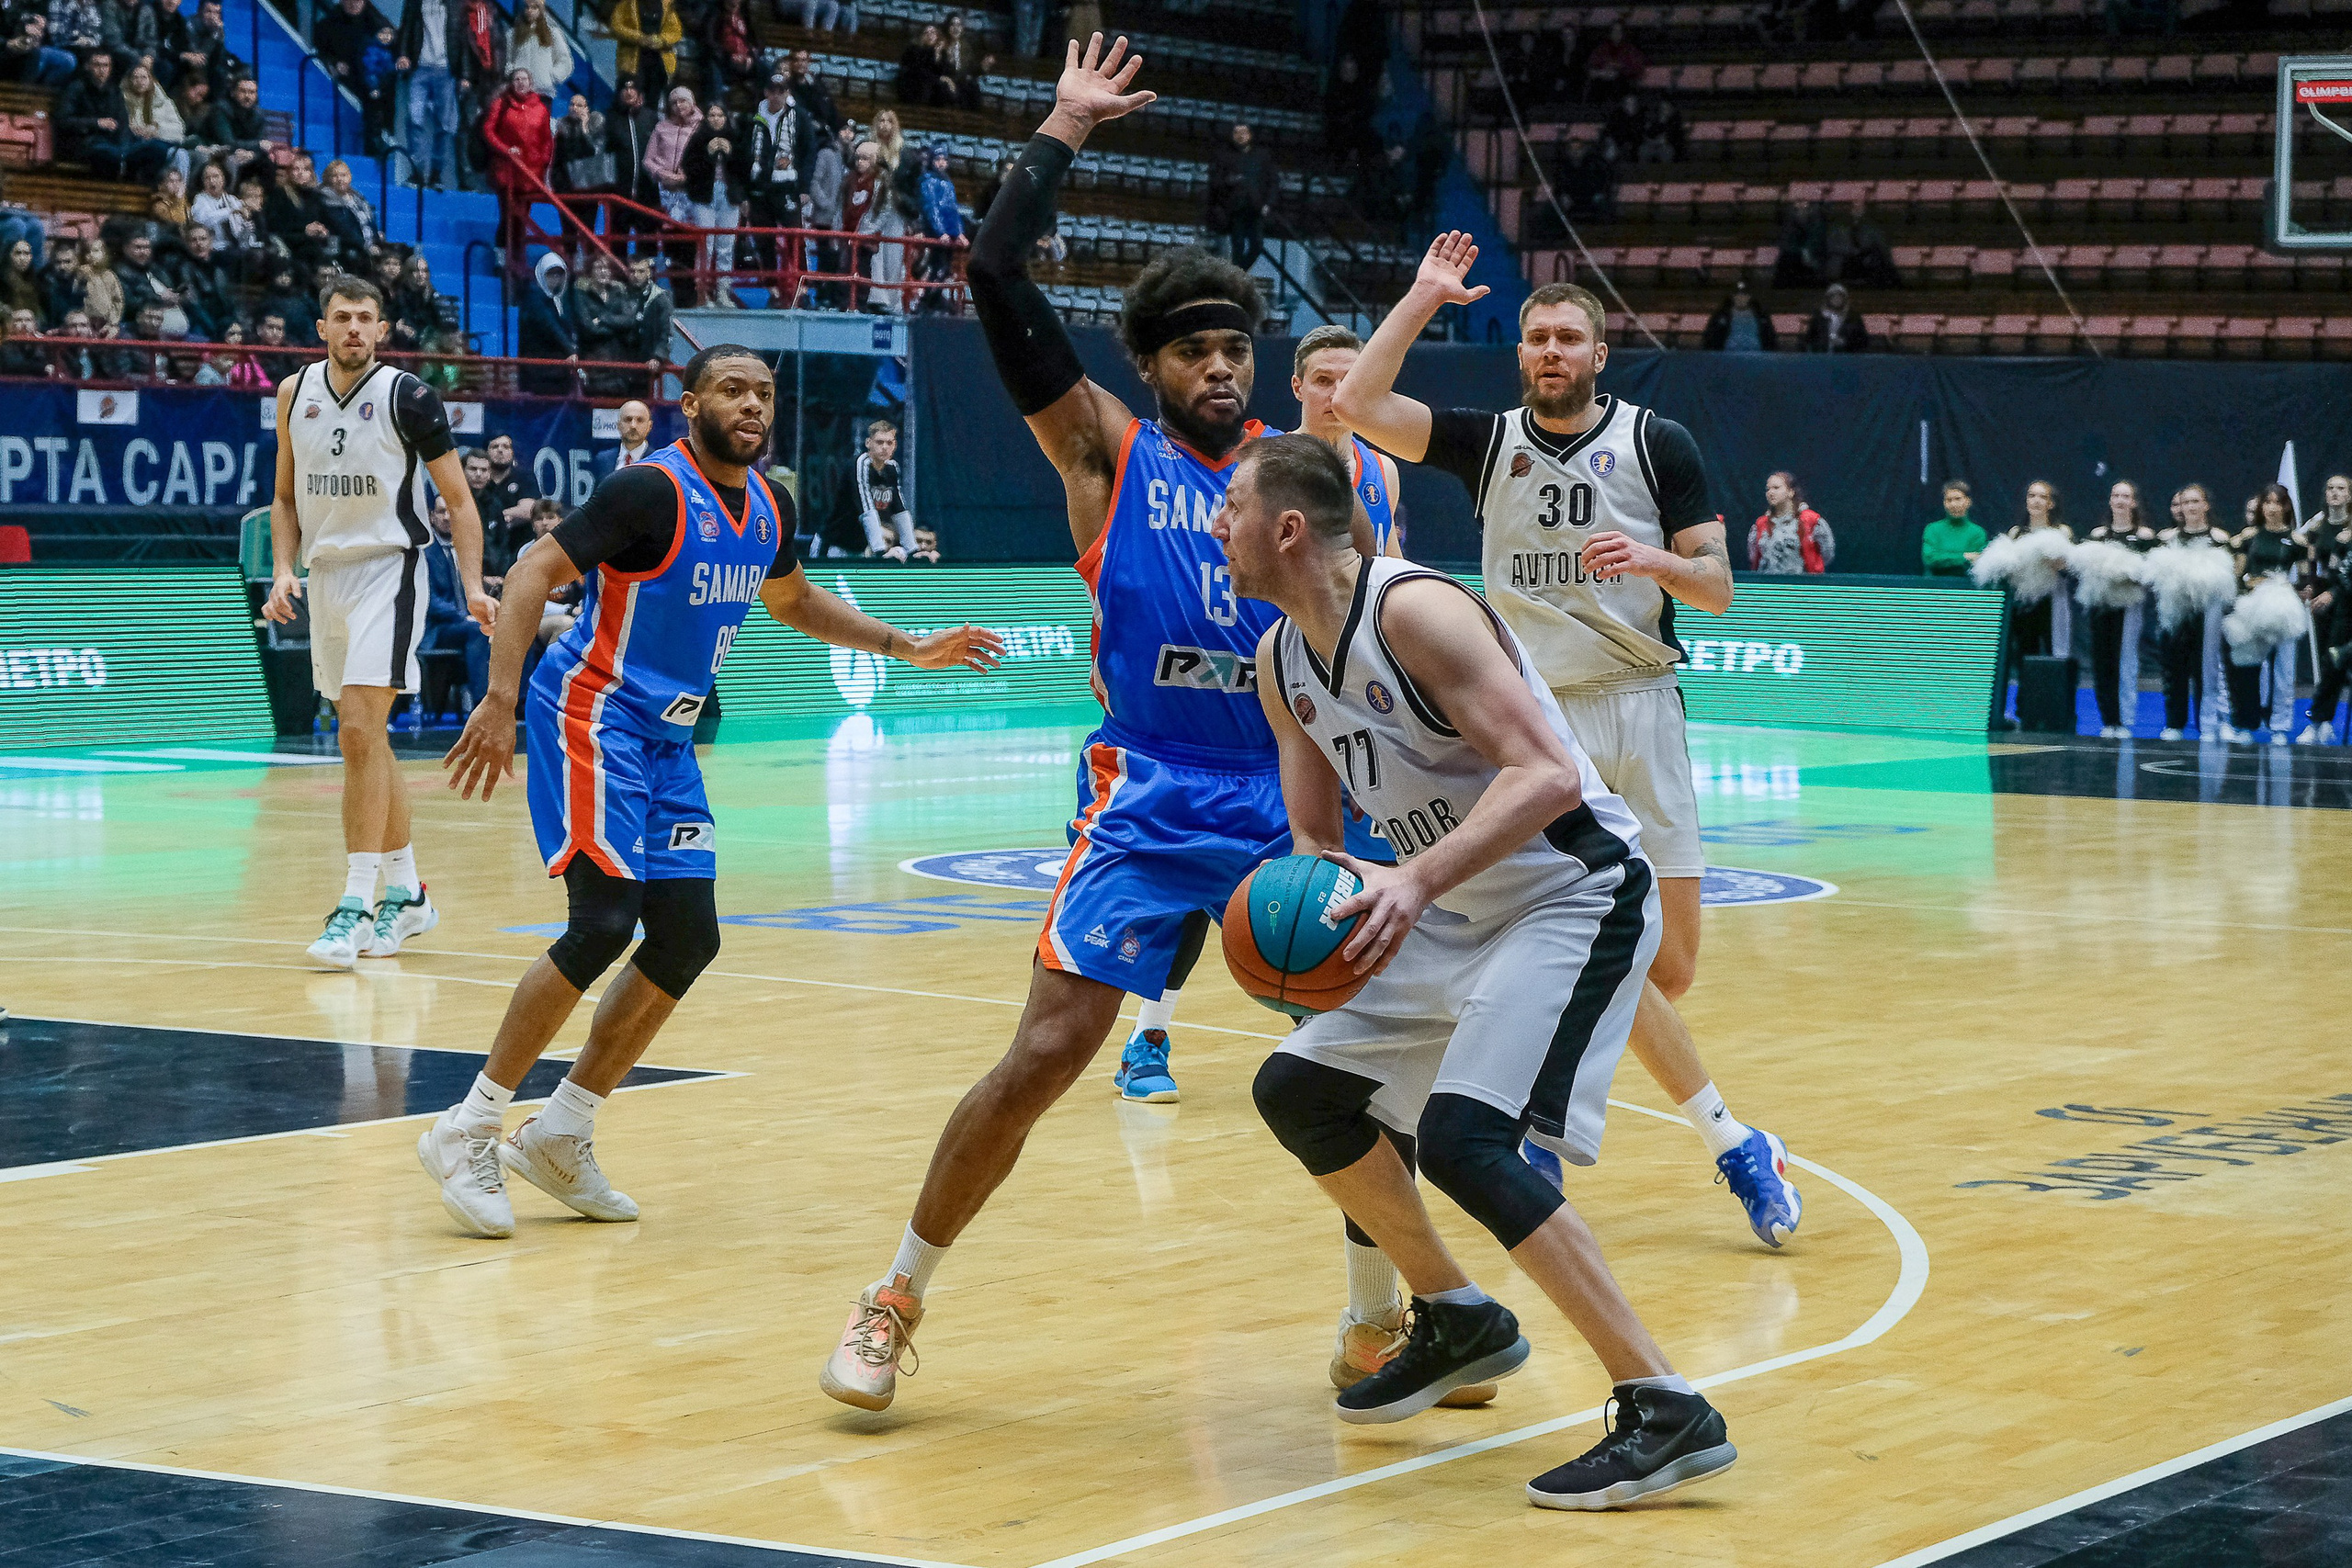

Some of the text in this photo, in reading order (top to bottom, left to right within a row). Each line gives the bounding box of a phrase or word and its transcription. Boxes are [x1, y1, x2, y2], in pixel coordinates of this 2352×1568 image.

[331, 427, 347, 457] 3
[1538, 482, 1594, 529] 30
[1200, 561, 1238, 627] 13
[1332, 728, 1381, 792] 77
[1082, 933, 1111, 949] PEAK
